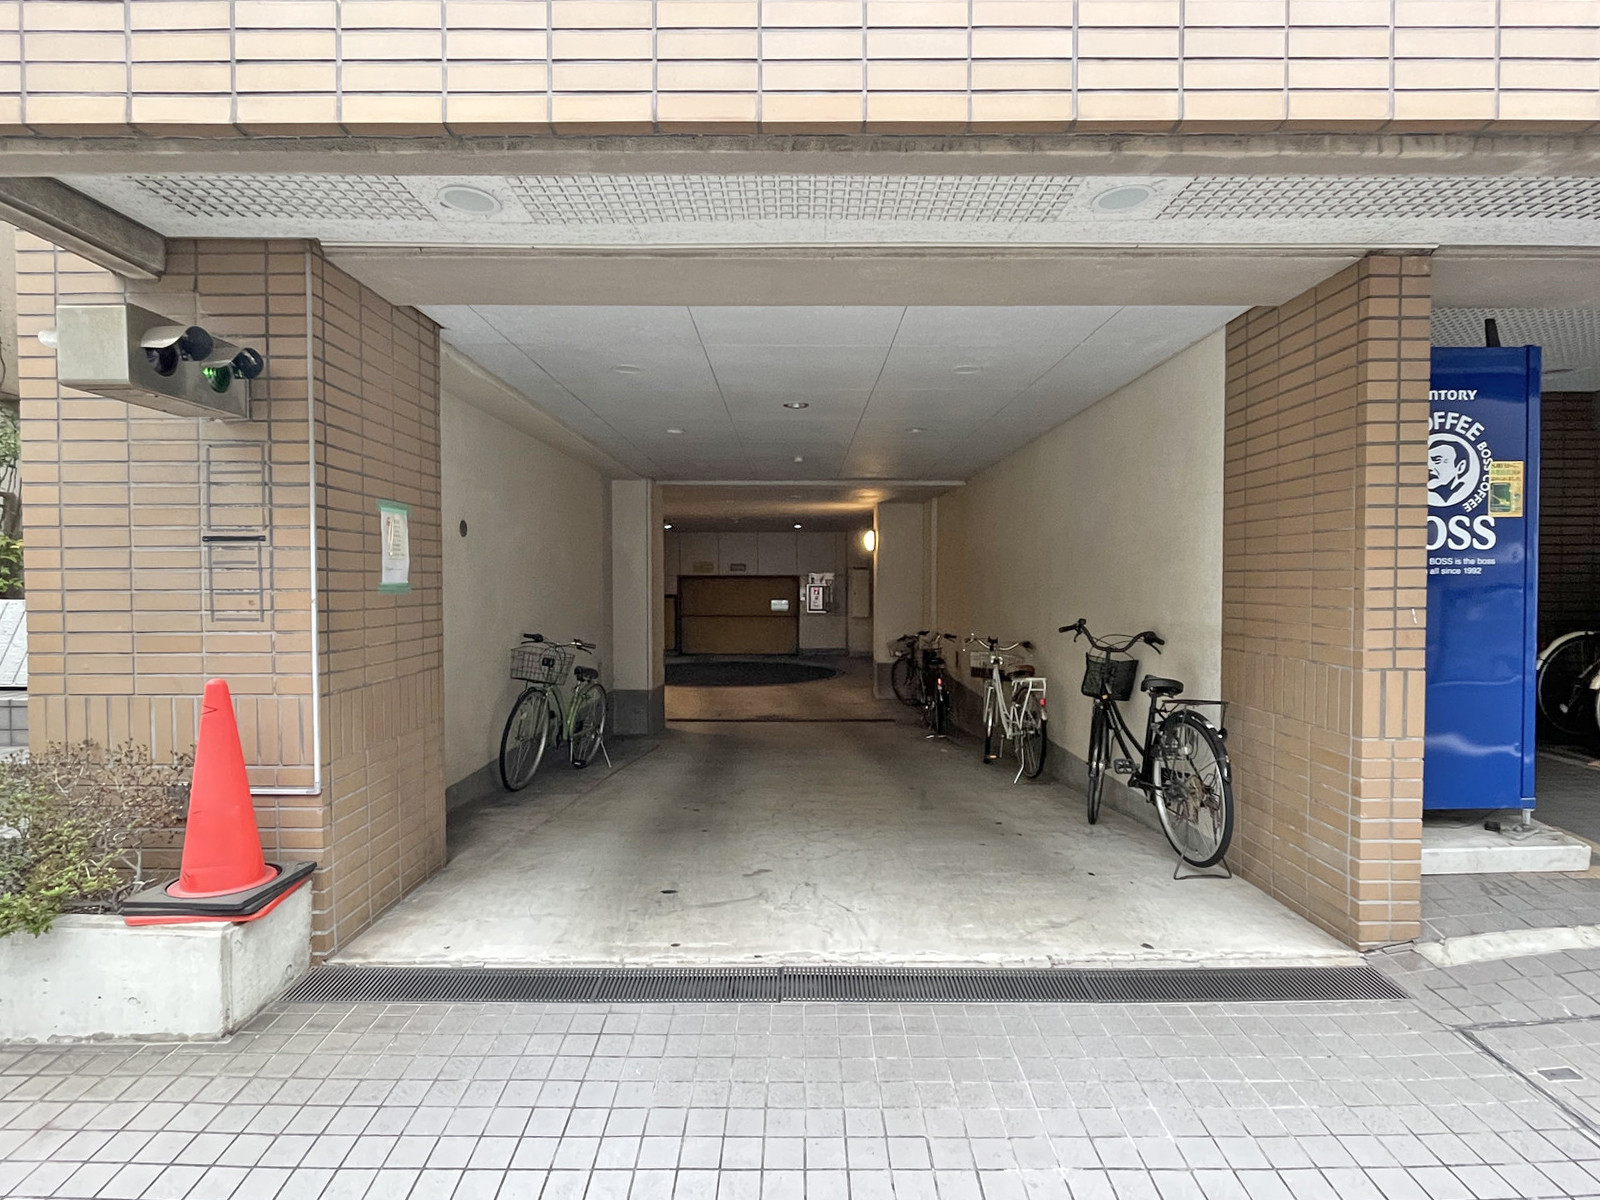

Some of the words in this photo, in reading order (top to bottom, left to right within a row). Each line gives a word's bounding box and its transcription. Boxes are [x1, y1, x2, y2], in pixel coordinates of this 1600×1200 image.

[1429, 557, 1453, 565] BOSS
[1454, 557, 1462, 565] is
[1463, 557, 1475, 565] the
[1477, 557, 1496, 565] boss
[1429, 567, 1440, 575] all
[1441, 567, 1461, 575] since
[1463, 567, 1482, 575] 1992
